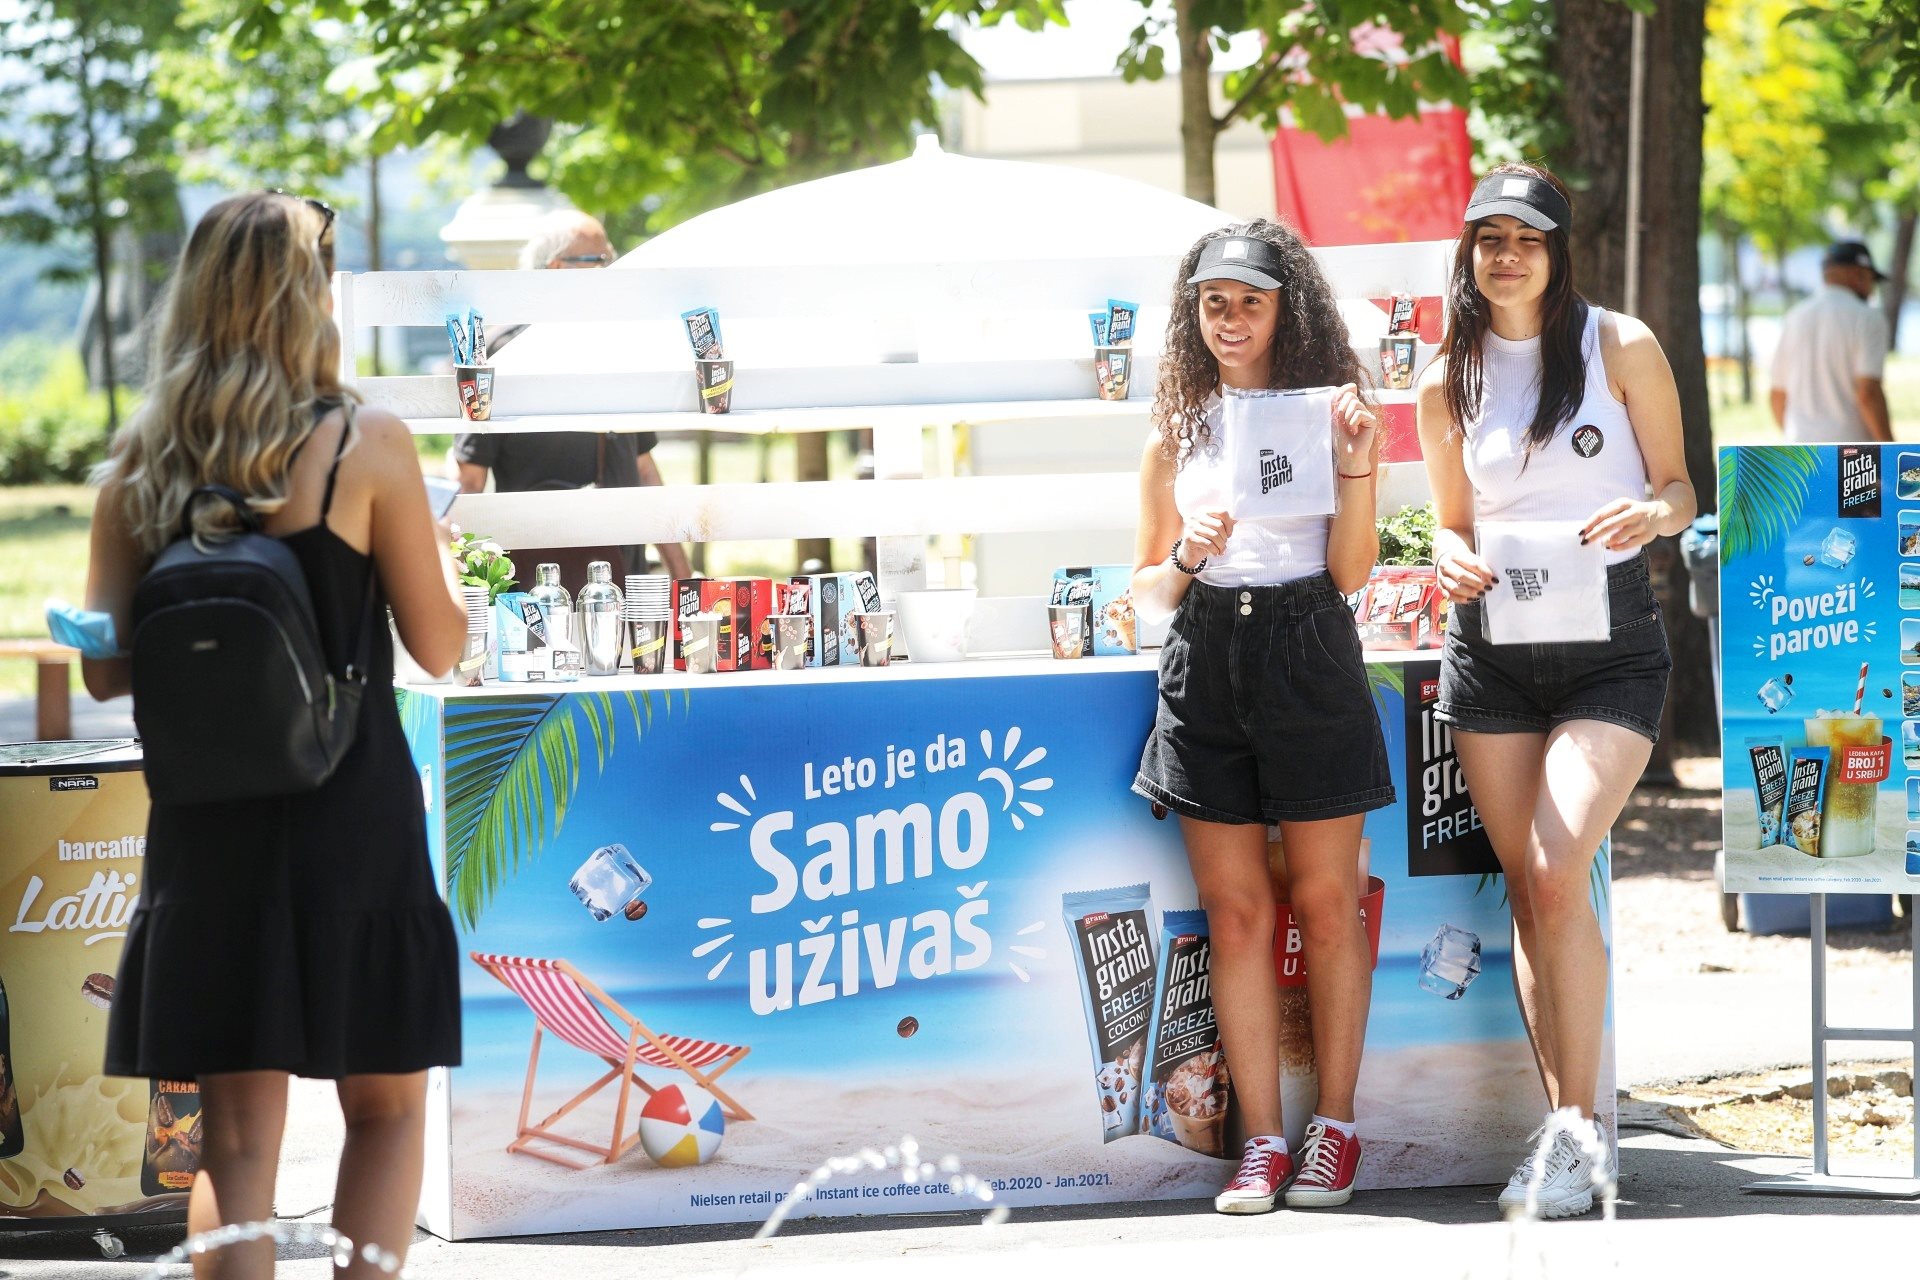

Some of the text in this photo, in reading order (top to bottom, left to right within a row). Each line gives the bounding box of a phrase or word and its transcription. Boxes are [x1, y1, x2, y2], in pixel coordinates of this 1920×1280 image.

[1577, 429, 1593, 449] Insta
[1582, 432, 1599, 458] grand
[1260, 454, 1289, 477] Insta
[1843, 453, 1873, 478] Insta
[1262, 464, 1293, 495] grand
[1843, 463, 1877, 498] grand
[1843, 488, 1877, 509] FREEZE
[1771, 582, 1856, 625] Poveži
[1770, 619, 1859, 661] parove
[804, 733, 966, 800] Leto je da
[1755, 749, 1779, 770] Insta
[1758, 756, 1783, 786] grand
[1793, 761, 1817, 780] Insta
[1847, 755, 1884, 769] BROJ 1
[58, 779, 96, 788] NARA
[1761, 775, 1786, 795] FREEZE
[1790, 770, 1819, 796] grand
[1846, 768, 1883, 779] U SRBIJI
[1422, 757, 1469, 817] gra
[1789, 789, 1816, 804] FREEZE
[1422, 805, 1483, 850] FREE
[58, 835, 147, 860] barcaffé
[749, 791, 989, 914] Samo
[1085, 913, 1109, 925] grand
[749, 880, 993, 1015] uživaš
[1087, 918, 1139, 966] Insta
[1177, 935, 1198, 945] grand
[1096, 933, 1151, 1001] grand
[1169, 942, 1211, 985] Inst
[1101, 977, 1155, 1023] FREEZE
[1163, 974, 1212, 1021] gran
[1108, 1005, 1152, 1040] COCONU
[1159, 1006, 1216, 1043] FREEZE
[1163, 1033, 1206, 1058] CLASSIC
[159, 1080, 200, 1094] CARAM
[1567, 1159, 1581, 1174] FILA
[690, 1193, 736, 1207] Nielsen
[739, 1190, 771, 1204] retail
[816, 1186, 859, 1200] Instant
[862, 1185, 880, 1198] ice
[883, 1183, 921, 1196] coffee
[1054, 1173, 1112, 1188] Jan.2021.
